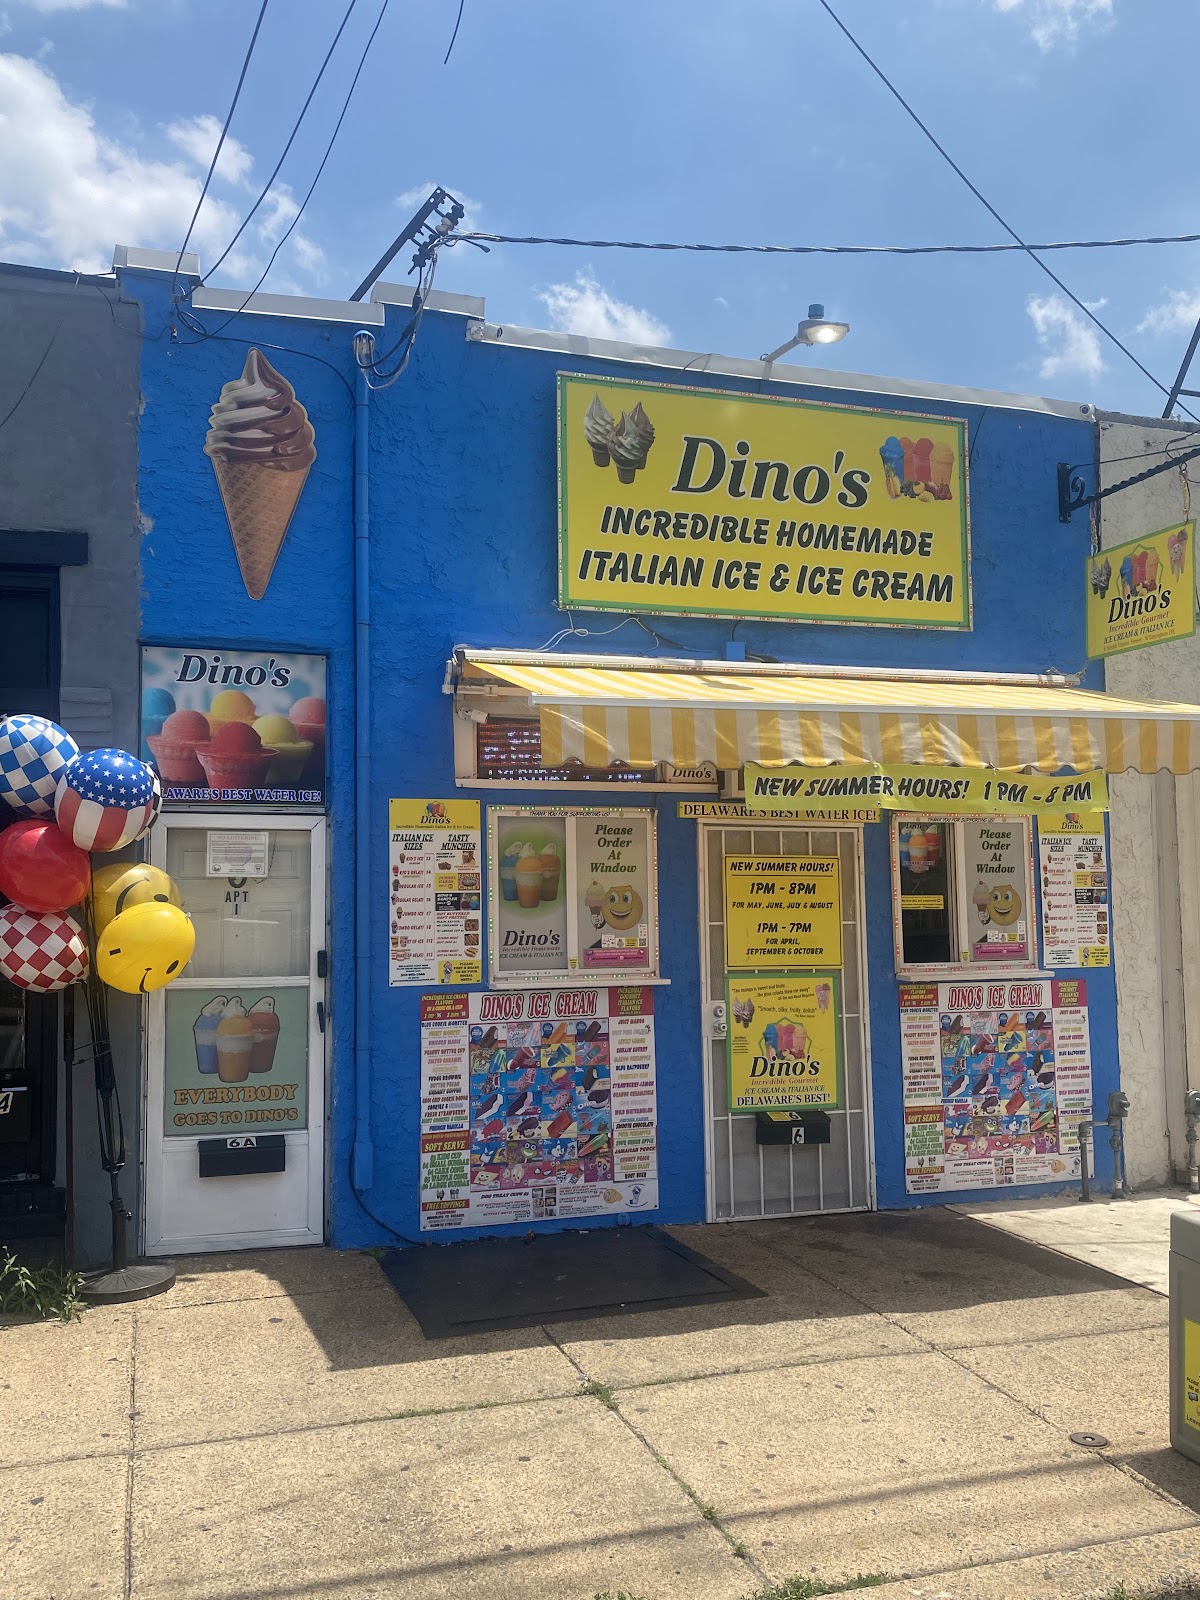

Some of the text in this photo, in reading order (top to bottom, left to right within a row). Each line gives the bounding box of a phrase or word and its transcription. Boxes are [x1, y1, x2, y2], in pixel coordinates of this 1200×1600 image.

[672, 434, 870, 508] Dino's
[600, 506, 933, 557] INCREDIBLE HOMEMADE
[578, 549, 953, 603] ITALIAN ICE & ICE CREAM
[1108, 584, 1171, 623] Dino's
[1109, 611, 1169, 633] Incredible Gourmet
[1104, 634, 1113, 645] ICE
[1114, 630, 1134, 643] CREAM
[1134, 628, 1139, 636] &
[1140, 621, 1164, 636] ITALIAN
[1165, 619, 1175, 629] ICE
[175, 654, 291, 687] Dino's
[161, 788, 321, 802] LAWARE'S BEST WATER ICE!
[754, 776, 804, 797] NEW
[804, 775, 894, 797] SUMMER
[898, 777, 970, 799] HOURS!
[984, 781, 992, 800] 1
[996, 781, 1028, 803] PM
[1045, 786, 1060, 803] 8
[1061, 781, 1092, 802] PM
[684, 804, 767, 818] DELAWARES
[806, 810, 849, 820] WATER
[853, 810, 876, 820] ICE!
[420, 815, 450, 824] Dino's
[595, 825, 633, 835] Please
[1061, 822, 1084, 830] Dino's
[392, 834, 422, 842] ITALIAN
[448, 834, 470, 842] TASTY
[979, 829, 1012, 839] Please
[441, 842, 476, 850] MUNCHIES
[597, 838, 632, 848] Order
[982, 841, 1012, 851] Order
[607, 850, 621, 860] At
[990, 852, 1002, 862] At
[590, 862, 636, 873] Window
[730, 862, 834, 872] NEW SUMMER HOURS!
[976, 864, 1016, 874] Window
[750, 882, 776, 894] 1PM
[788, 882, 816, 894] 8PM
[225, 890, 248, 902] APT
[758, 922, 778, 933] 1PM
[790, 922, 812, 933] 7PM
[503, 929, 560, 946] Dino's
[948, 986, 983, 1010] DINO'S
[987, 985, 1005, 1008] ICE
[1008, 984, 1042, 1007] CREAM
[480, 993, 523, 1020] DINO'S
[528, 992, 551, 1018] ICE
[555, 990, 598, 1016] CREAM
[749, 1055, 820, 1077] Dino's
[752, 1078, 786, 1086] Incredible
[174, 1084, 298, 1105] EVERYBODY
[737, 1093, 830, 1106] DELAWARE'S BEST!
[0, 1092, 9, 1112] 4
[173, 1108, 298, 1126] GOES TO DINO'S
[908, 1114, 940, 1123] SOFT SERVE
[228, 1138, 256, 1148] 6A
[424, 1140, 466, 1152] SOFT SERVE
[440, 1201, 465, 1209] TOPPINGS
